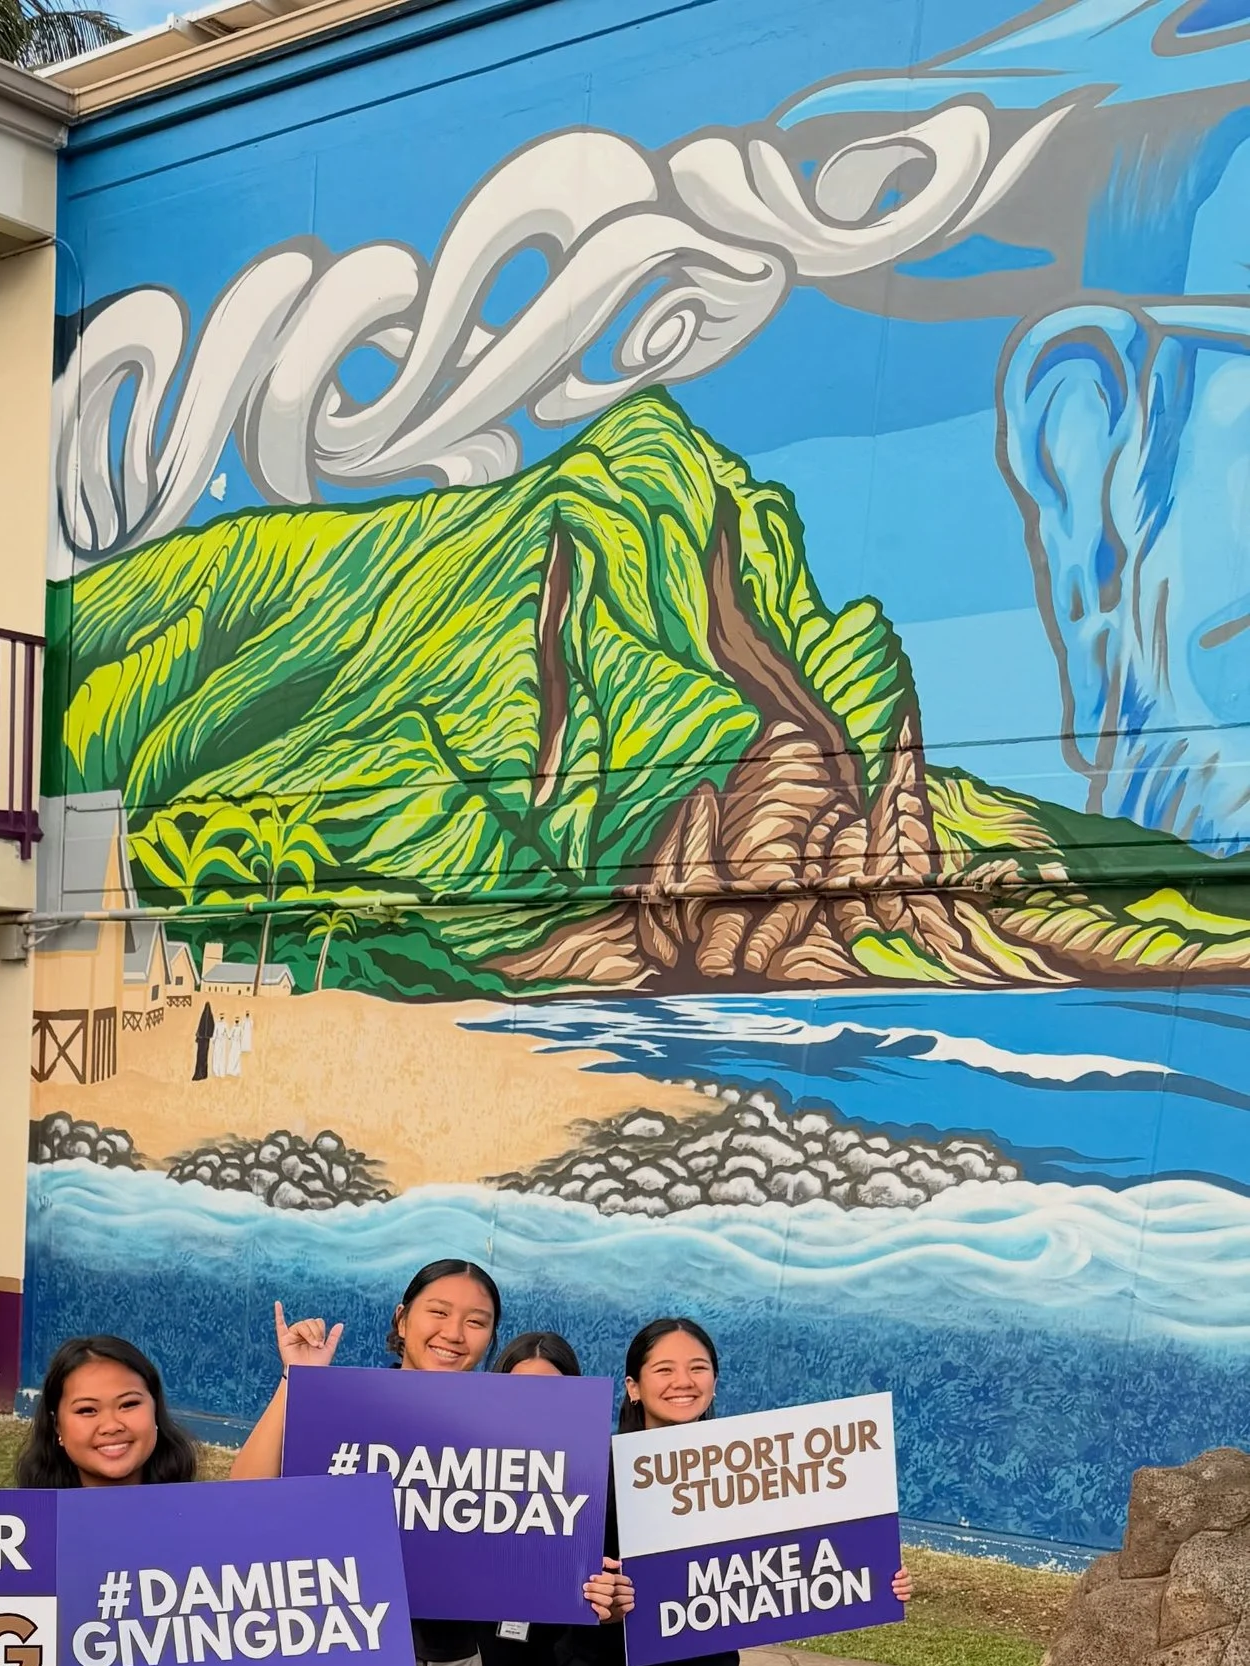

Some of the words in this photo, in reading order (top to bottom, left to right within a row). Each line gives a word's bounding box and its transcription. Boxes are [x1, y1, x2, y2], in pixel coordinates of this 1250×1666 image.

[327, 1442, 566, 1493] #DAMIEN
[632, 1431, 795, 1489] SUPPORT
[803, 1418, 882, 1461] OUR
[670, 1457, 848, 1516] STUDENTS
[97, 1556, 362, 1620] #DAMIEN
[687, 1543, 802, 1598] MAKE
[810, 1537, 843, 1576] A
[659, 1566, 872, 1638] DONATION
